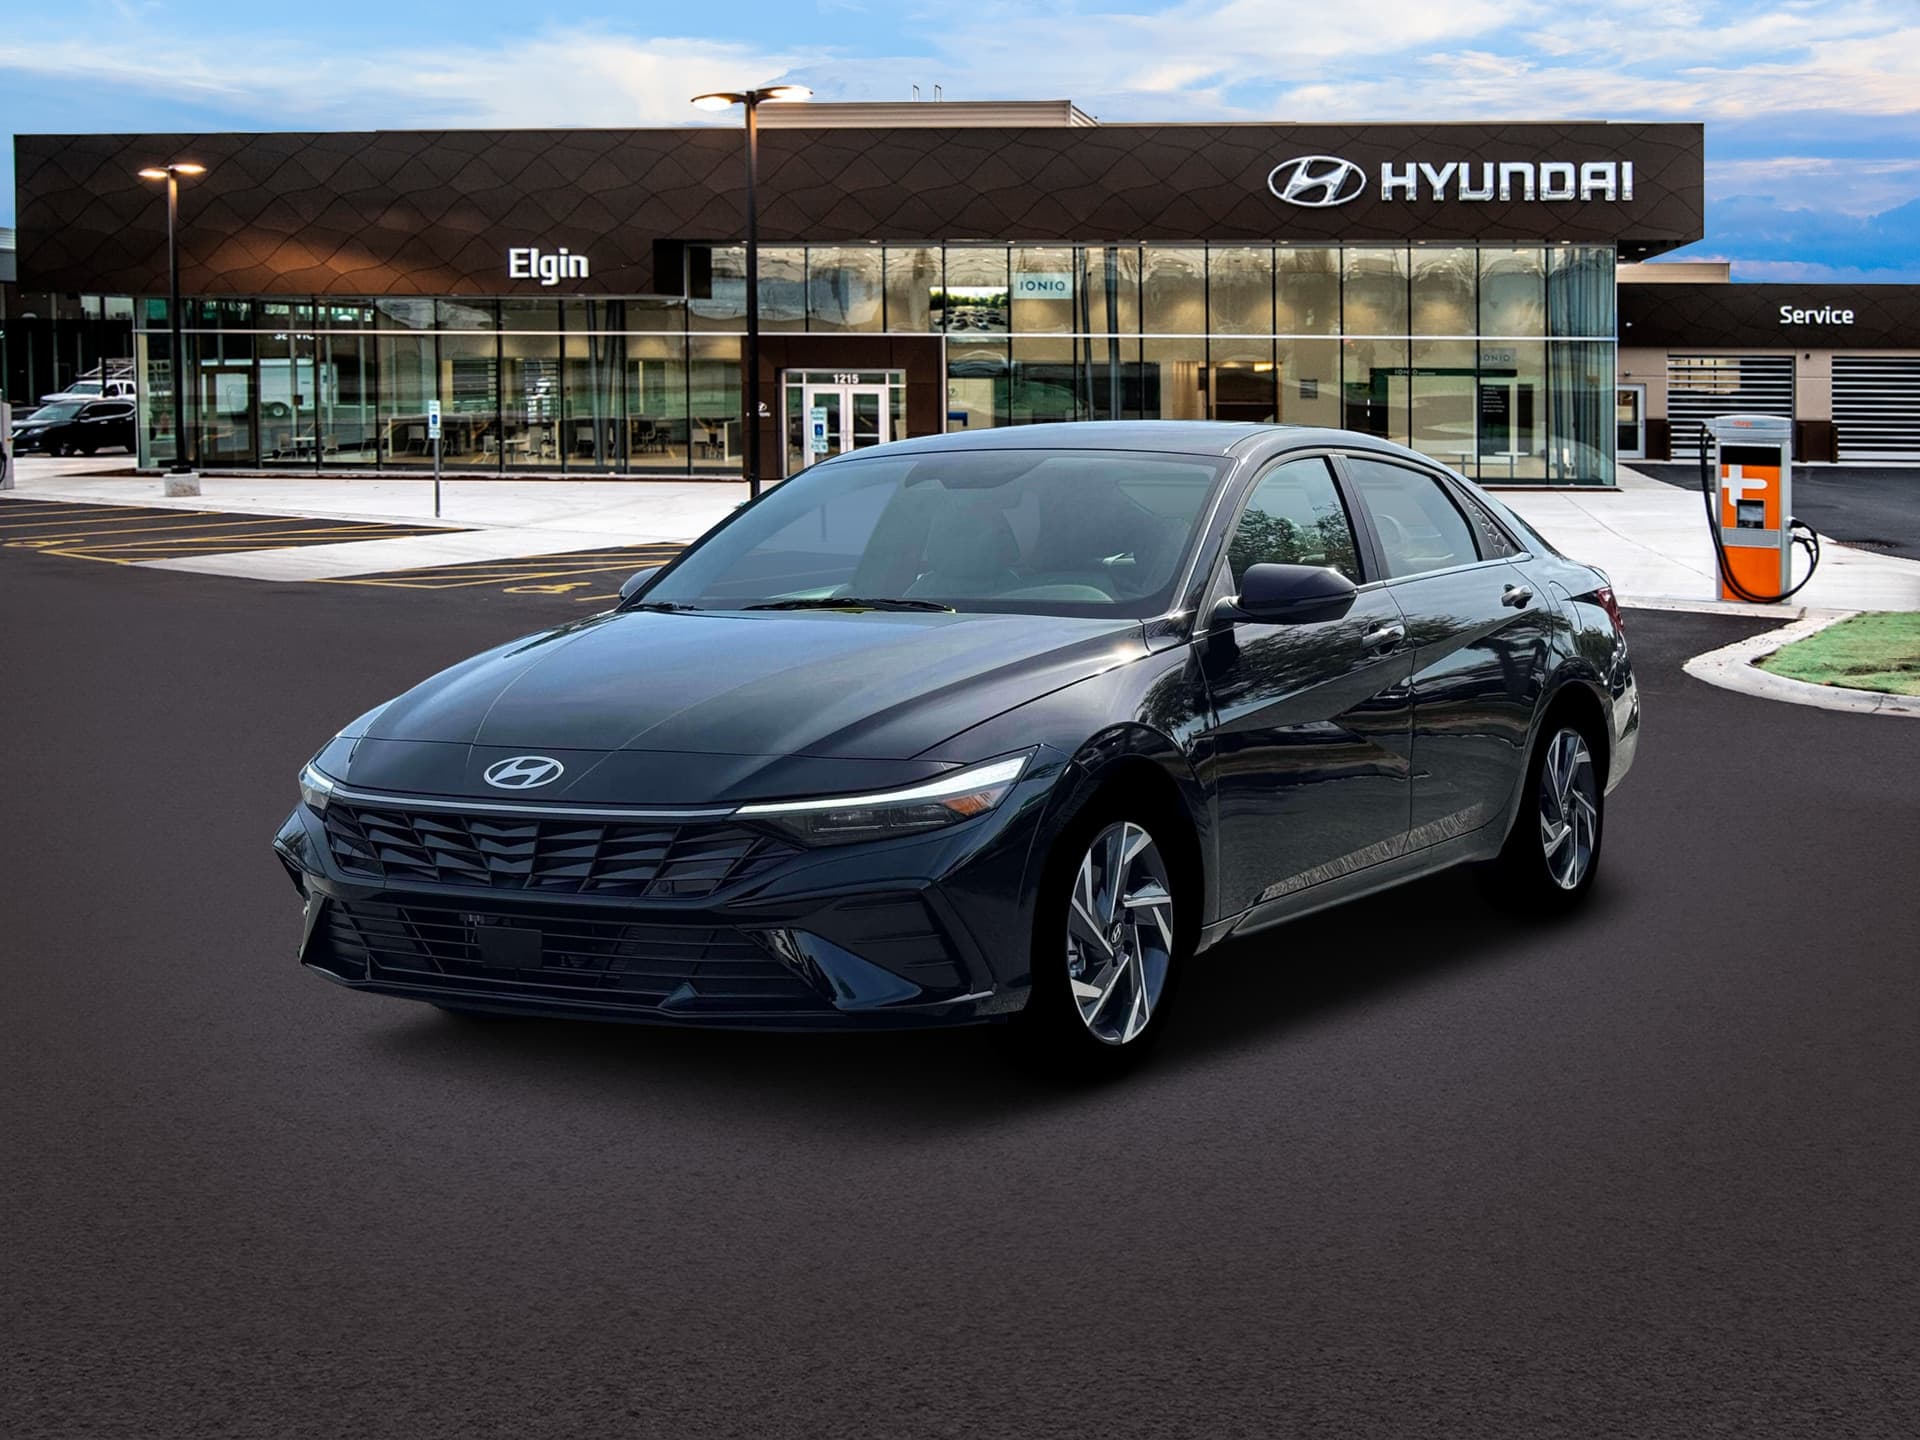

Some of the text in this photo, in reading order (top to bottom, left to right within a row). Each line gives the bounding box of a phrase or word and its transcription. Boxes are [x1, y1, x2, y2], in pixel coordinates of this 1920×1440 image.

[1381, 161, 1634, 202] HYUNDAI
[509, 247, 590, 286] Elgin
[1020, 280, 1066, 292] IONIQ
[1779, 305, 1855, 325] Service
[832, 373, 861, 384] 1215
